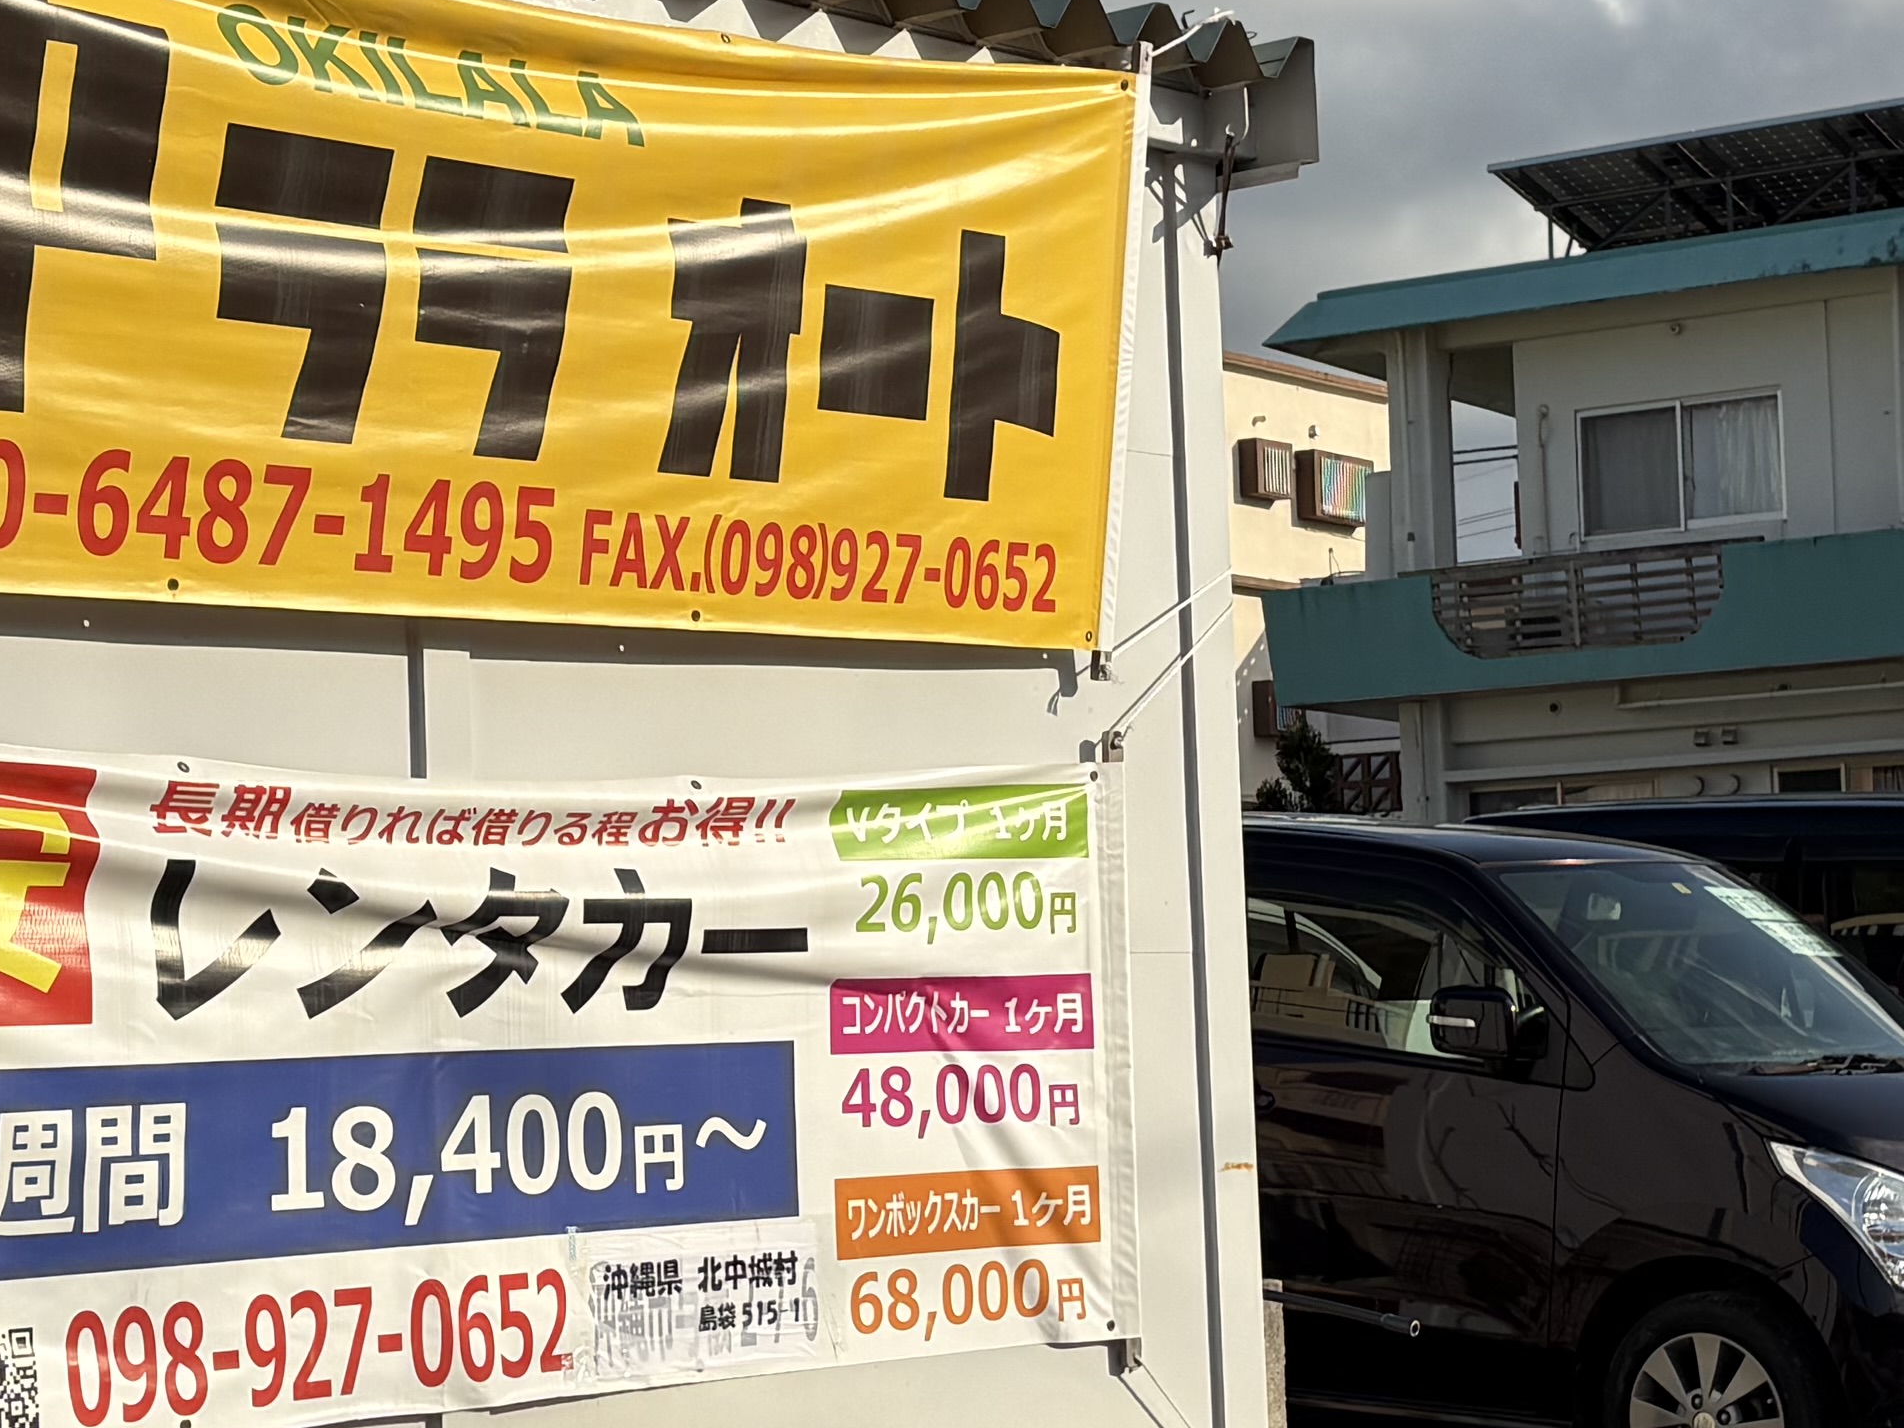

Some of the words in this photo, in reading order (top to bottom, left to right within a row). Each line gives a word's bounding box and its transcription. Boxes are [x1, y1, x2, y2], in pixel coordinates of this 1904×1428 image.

[217, 0, 647, 148] OKILALA
[581, 507, 1058, 614] FAX.(098)927-0652
[846, 799, 969, 844] Vタイプ
[150, 859, 808, 1021] レンタカー
[856, 871, 1076, 945] 26,000円
[842, 991, 990, 1035] コンパクトカー
[841, 1063, 1080, 1139] 48,000円
[847, 1190, 1001, 1241] ワンボックスカー
[603, 1258, 684, 1301] 沖縄県
[697, 1250, 798, 1293] 北中城村
[849, 1258, 1087, 1342] 68,000円
[64, 1267, 574, 1428] 098-927-0652
[698, 1302, 737, 1332] 島袋
[741, 1297, 800, 1328] 515-1
